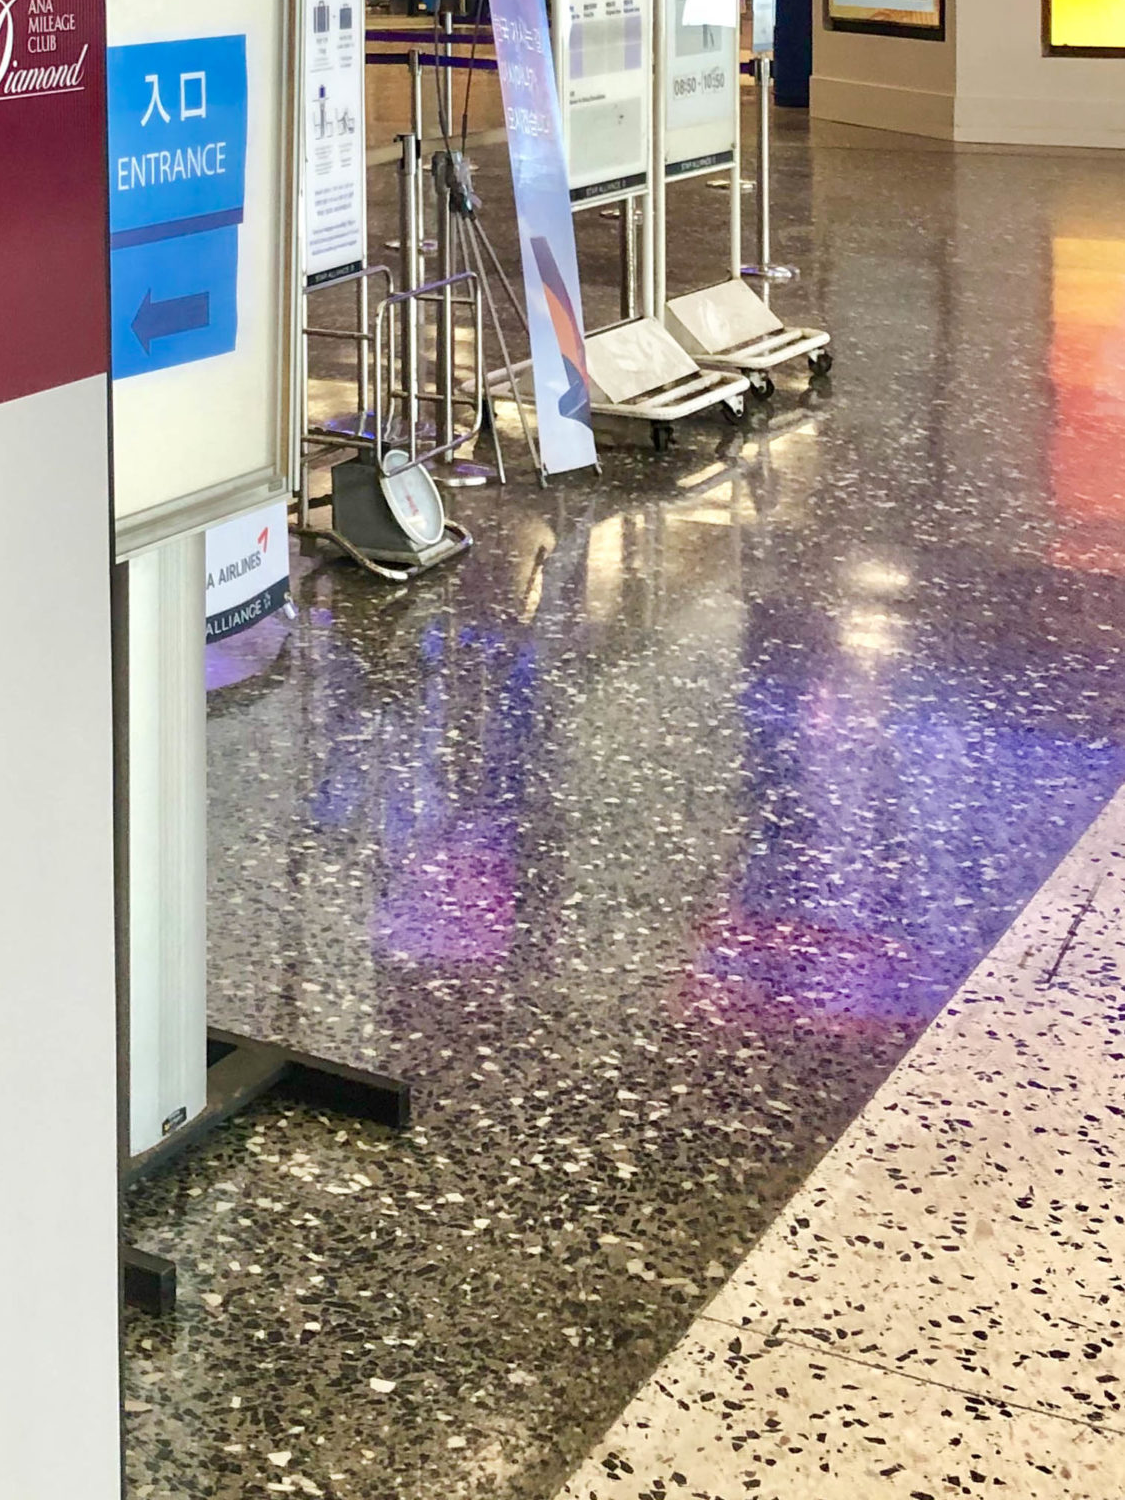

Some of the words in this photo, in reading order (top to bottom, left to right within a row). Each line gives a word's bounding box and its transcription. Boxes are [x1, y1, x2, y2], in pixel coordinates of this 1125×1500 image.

[27, 13, 76, 35] MILEAGE
[27, 35, 57, 54] CLUB
[140, 70, 207, 127] 入口
[117, 141, 227, 192] ENTRANCE
[218, 551, 262, 585] AIRLINES
[206, 599, 263, 636] ALLIANCE
